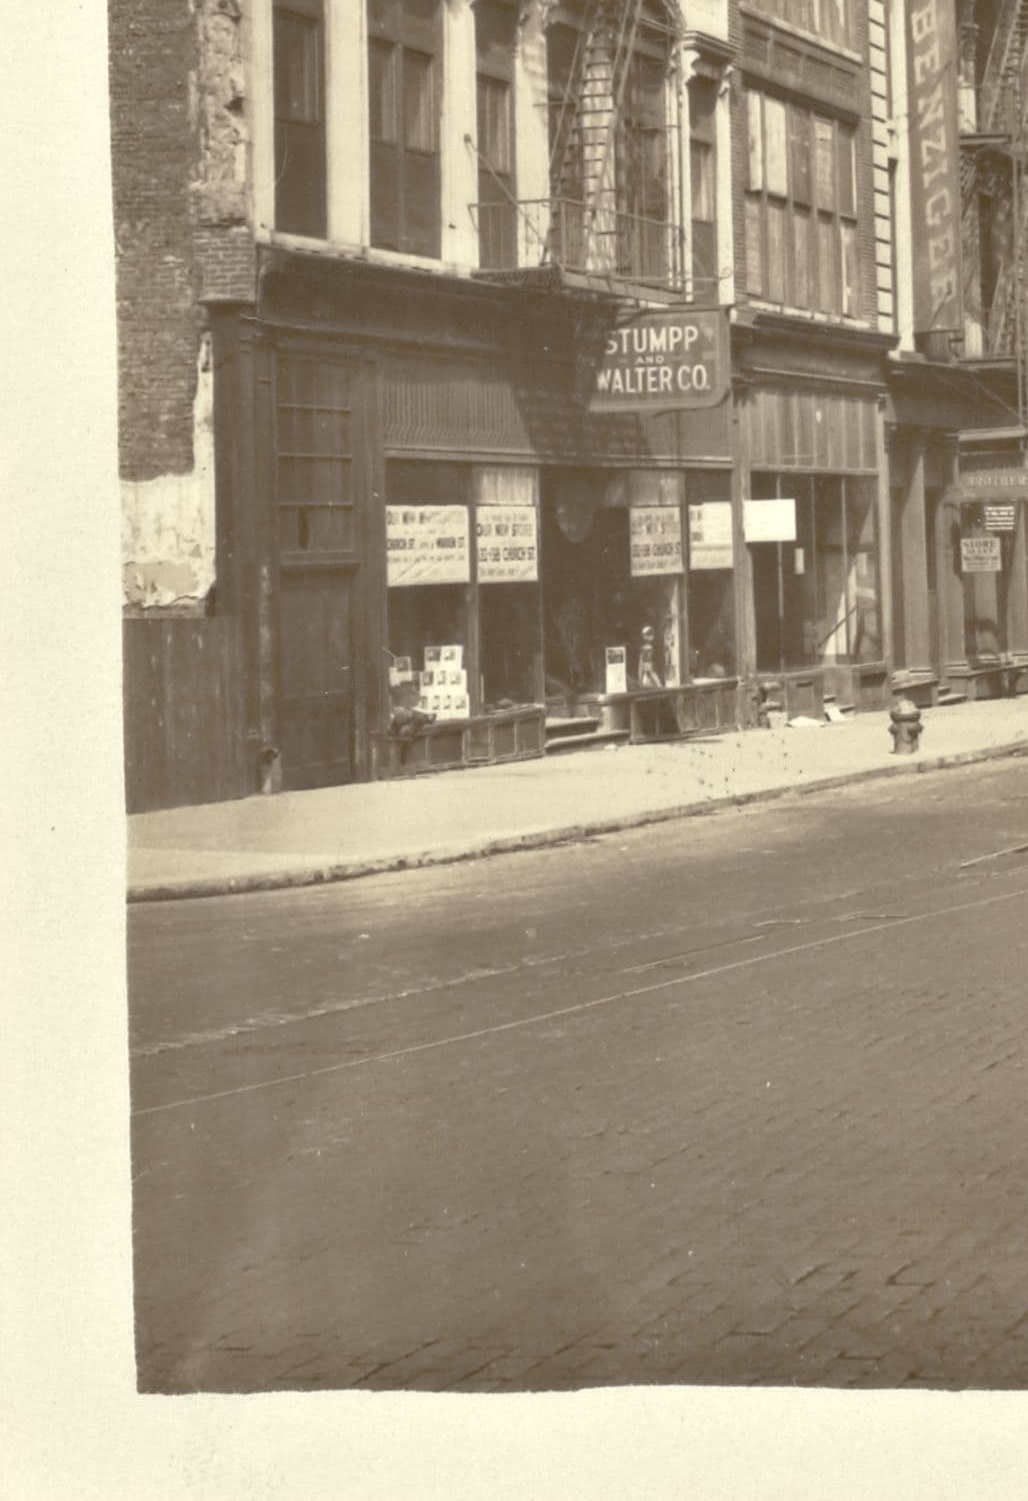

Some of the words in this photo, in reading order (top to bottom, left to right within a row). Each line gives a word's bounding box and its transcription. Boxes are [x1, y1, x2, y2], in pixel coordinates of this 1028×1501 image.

[604, 325, 699, 355] STUMPP
[635, 354, 665, 365] AND
[597, 366, 673, 395] WALTER
